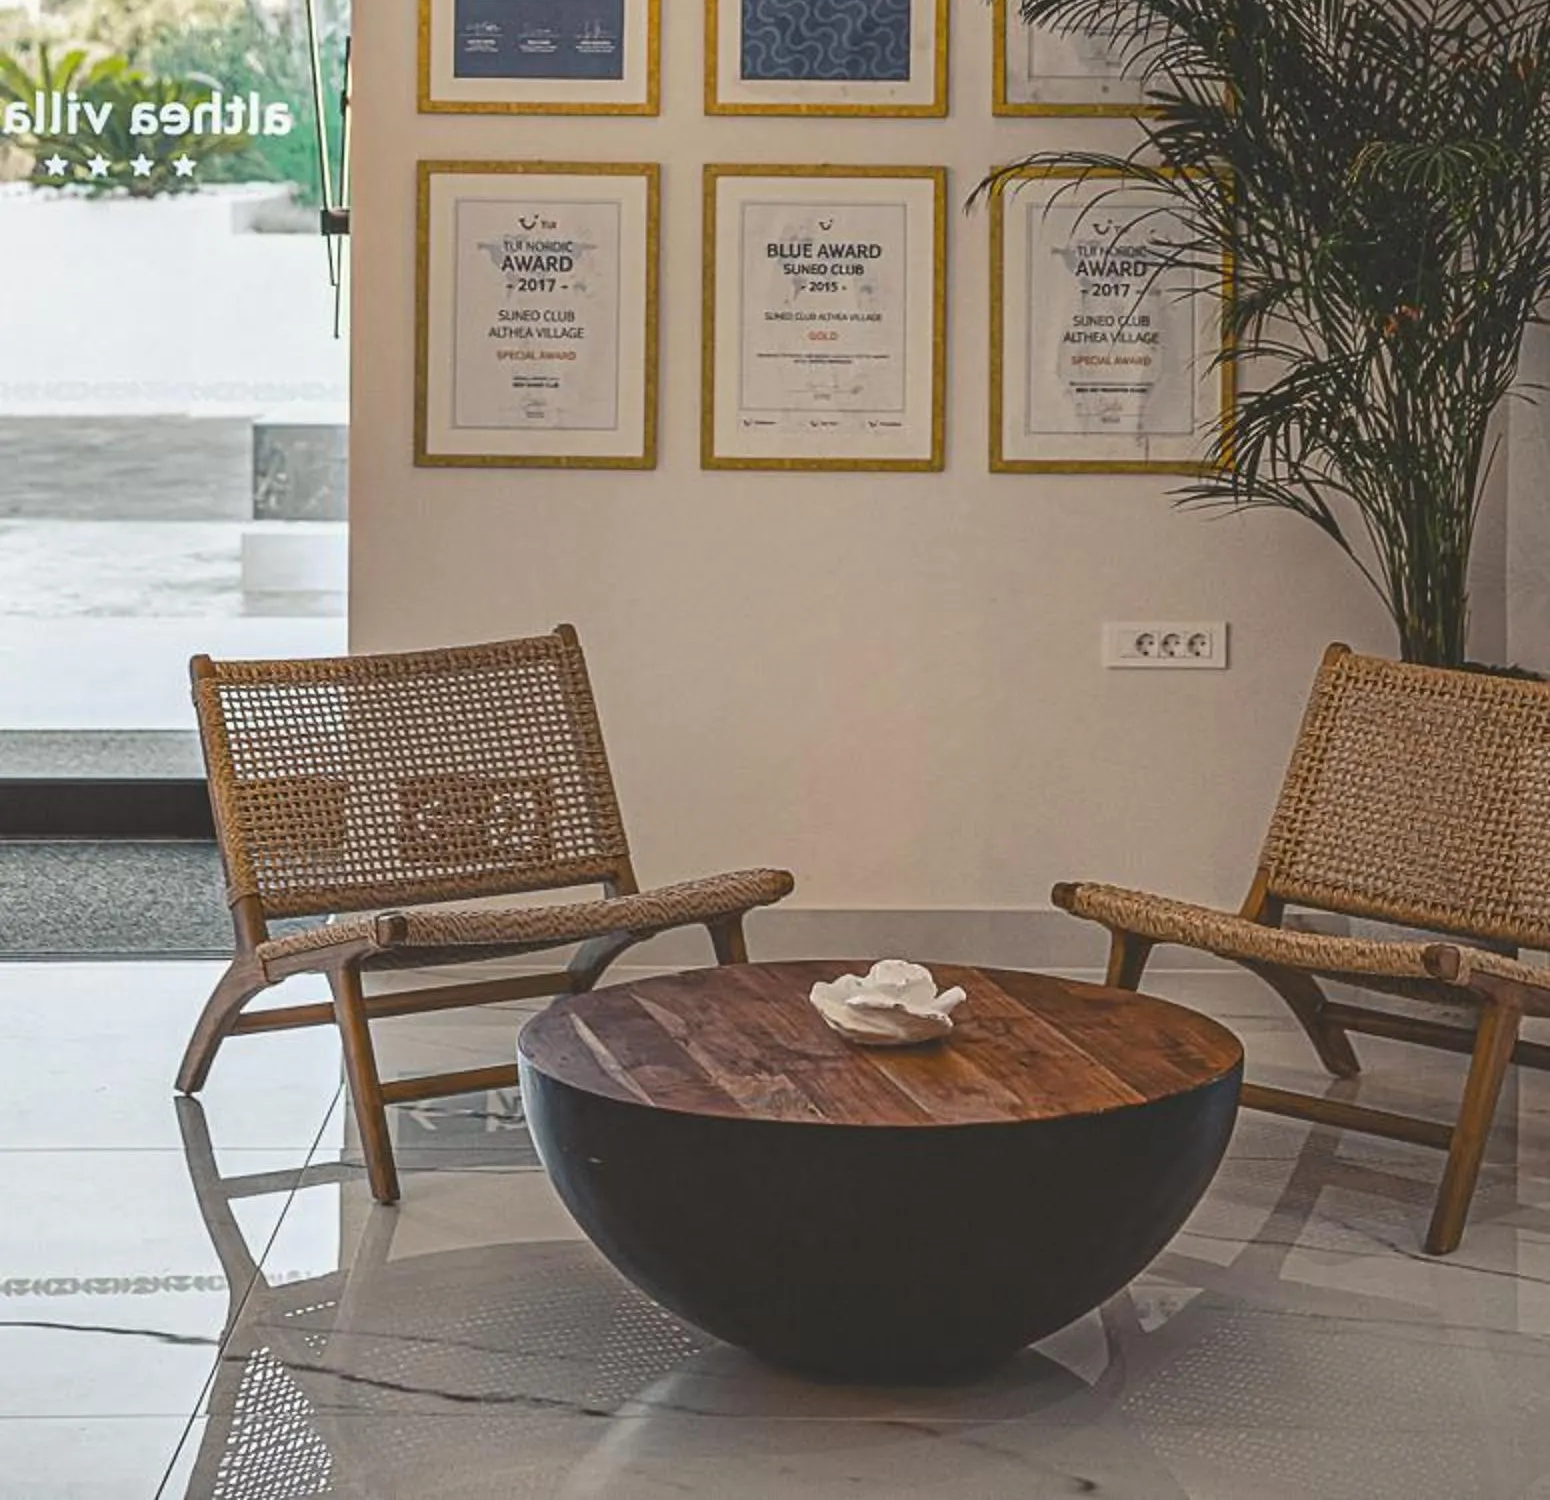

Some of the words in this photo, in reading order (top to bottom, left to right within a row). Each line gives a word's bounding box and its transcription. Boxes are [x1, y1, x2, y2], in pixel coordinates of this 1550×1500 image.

[503, 240, 523, 253] TUI
[526, 240, 573, 253] NORDIC
[767, 243, 813, 259] BLUE
[817, 244, 882, 260] AWARD
[501, 256, 573, 273] AWARD
[783, 264, 828, 276] SUNEO
[830, 264, 865, 276] CLUB
[1075, 260, 1147, 277] AWARD
[518, 278, 556, 293] 2017
[809, 281, 838, 293] 2015
[1091, 283, 1131, 298] 2017
[498, 309, 541, 322] SUNEO
[543, 309, 576, 323] CLUB
[764, 311, 793, 321] SUNEO
[795, 311, 817, 322] CLUB
[849, 312, 882, 322] VILLAGE
[1072, 315, 1115, 327] SUNEO
[1118, 315, 1150, 328] CLUB
[488, 327, 534, 339] ALTHEA
[536, 327, 585, 339] VILLAGE
[809, 331, 838, 341] GOLD
[1062, 331, 1107, 343] ALTHEA
[1110, 332, 1160, 344] VILLAGE
[496, 350, 536, 360] SPECIAL
[539, 350, 576, 361] AWARD
[1071, 355, 1111, 366] SPECIAL
[1113, 355, 1152, 367] AWARD
